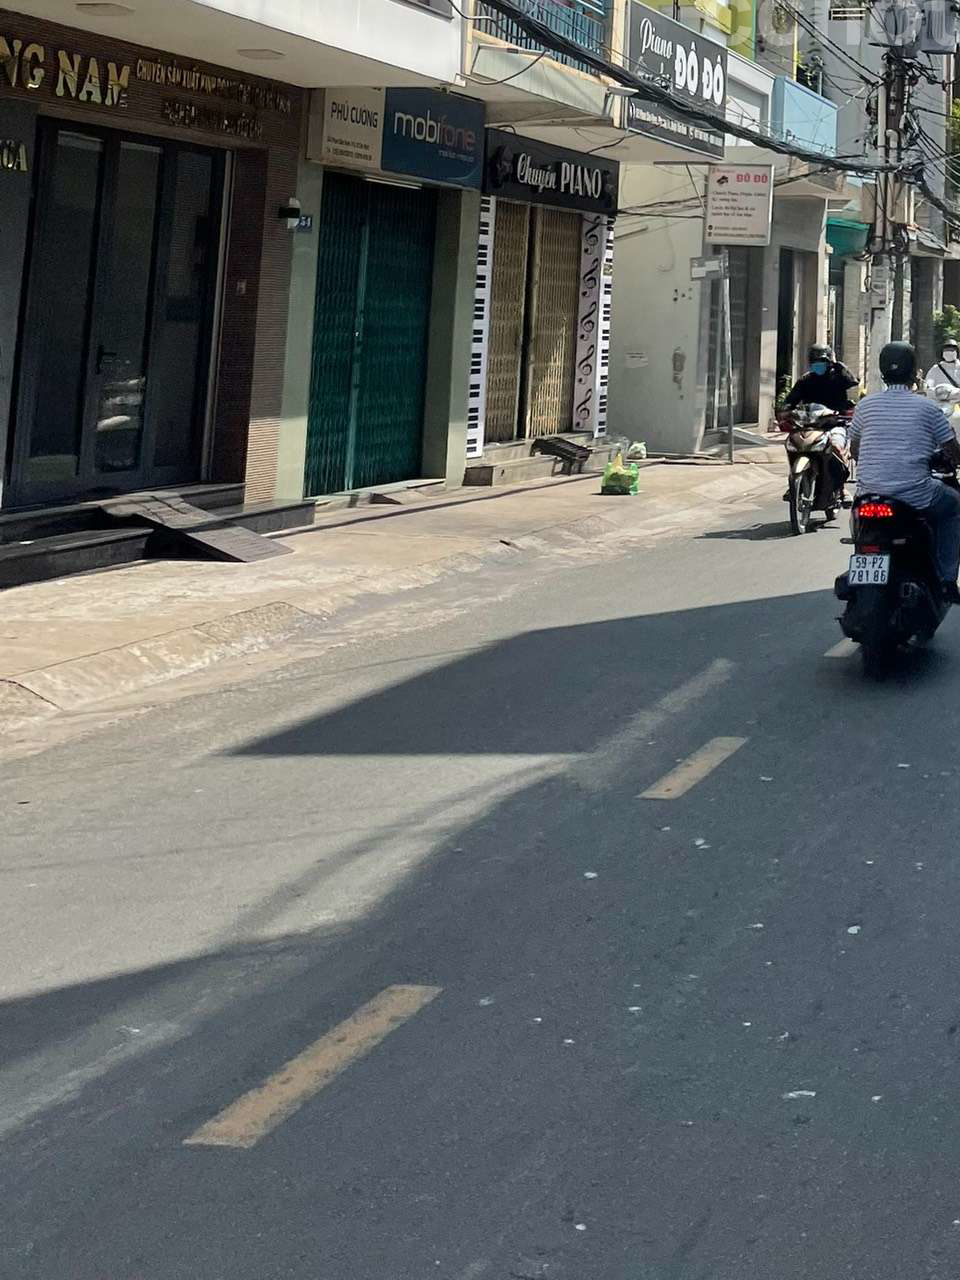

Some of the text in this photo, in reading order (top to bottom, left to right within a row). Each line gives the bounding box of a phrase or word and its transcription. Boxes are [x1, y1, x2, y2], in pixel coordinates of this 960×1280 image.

[640, 17, 673, 58] Piano
[55, 49, 131, 107] NAM
[675, 41, 699, 96] ĐÔ
[702, 54, 724, 106] ĐÔ
[393, 109, 477, 152] mobifone
[516, 153, 602, 199] Chuyên PIANO
